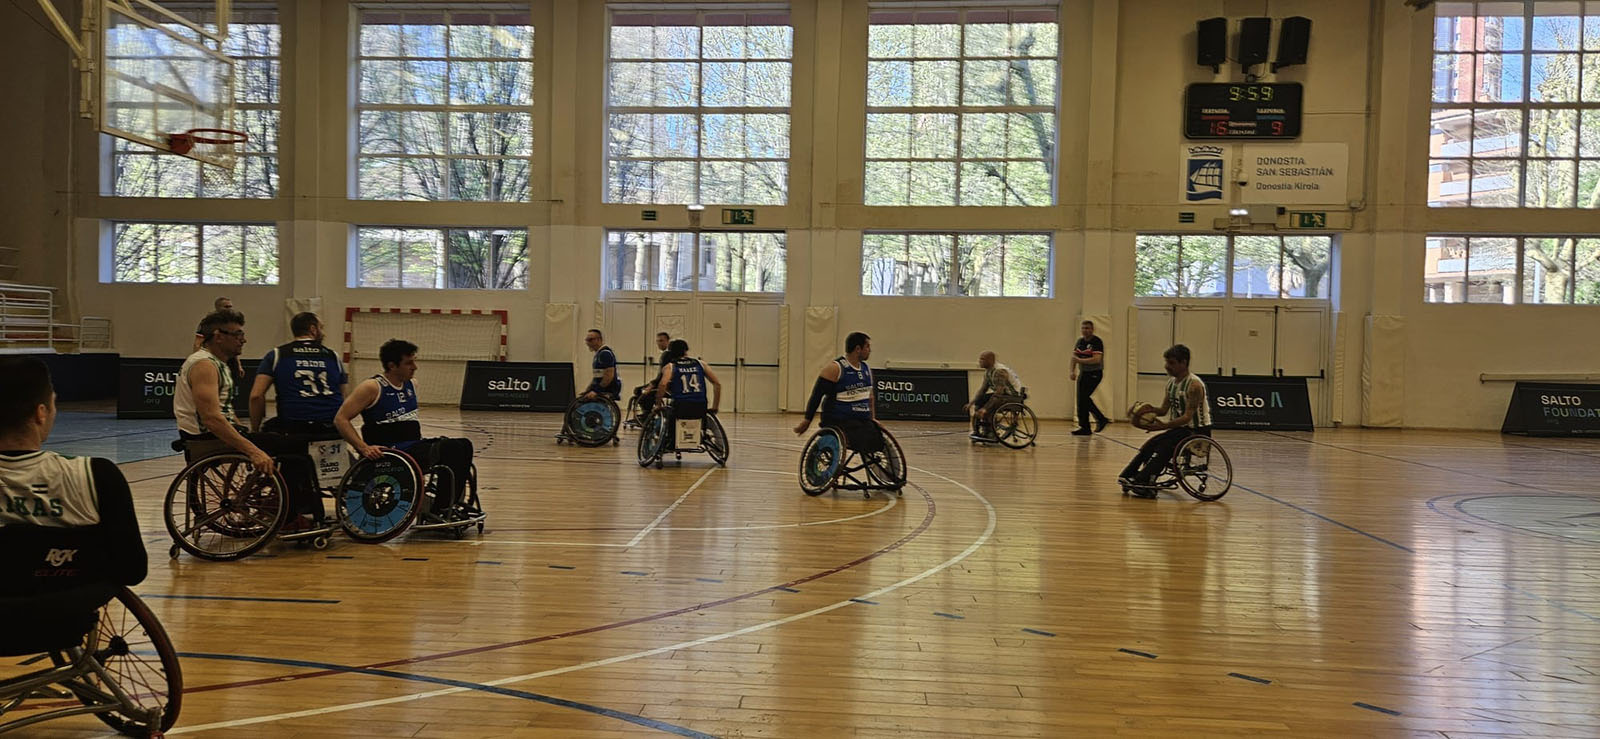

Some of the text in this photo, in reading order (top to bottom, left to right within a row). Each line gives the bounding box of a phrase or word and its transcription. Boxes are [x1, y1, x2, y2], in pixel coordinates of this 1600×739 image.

[1228, 86, 1273, 101] 9:59
[1256, 157, 1305, 166] DONOSTIA
[1256, 166, 1333, 176] SAN SEBASTIÁN
[1256, 182, 1319, 191] Donostia Kirola
[292, 345, 320, 353] salto
[144, 372, 180, 383] SALT
[294, 369, 335, 398] 31
[487, 377, 531, 391] salto
[680, 374, 701, 394] 14
[877, 381, 913, 391] SALTO
[878, 392, 949, 403] FOUNDATION
[1216, 393, 1265, 408] salto
[1540, 394, 1581, 406] SALTO
